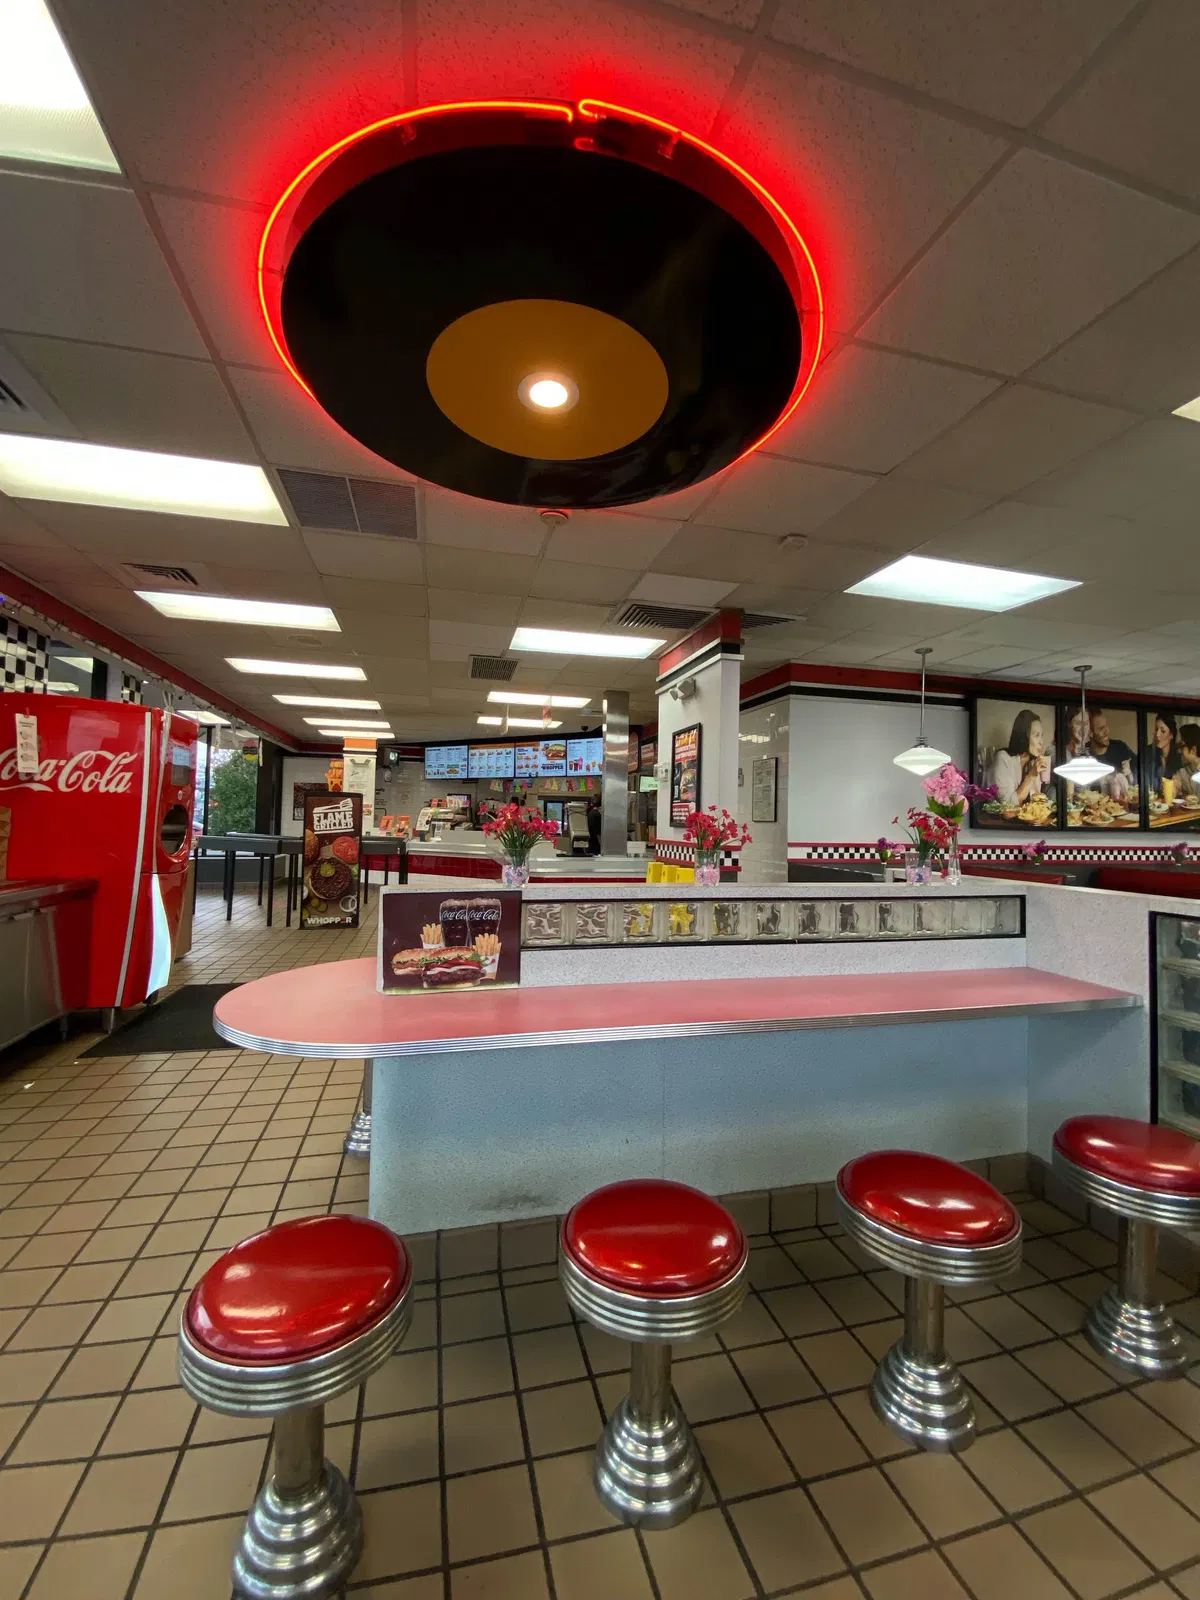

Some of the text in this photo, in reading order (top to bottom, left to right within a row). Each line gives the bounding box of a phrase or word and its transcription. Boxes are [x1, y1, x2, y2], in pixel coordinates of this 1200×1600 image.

[0, 748, 138, 793] oa-Cola
[313, 811, 353, 824] FLAME
[314, 818, 354, 831] GRILLED
